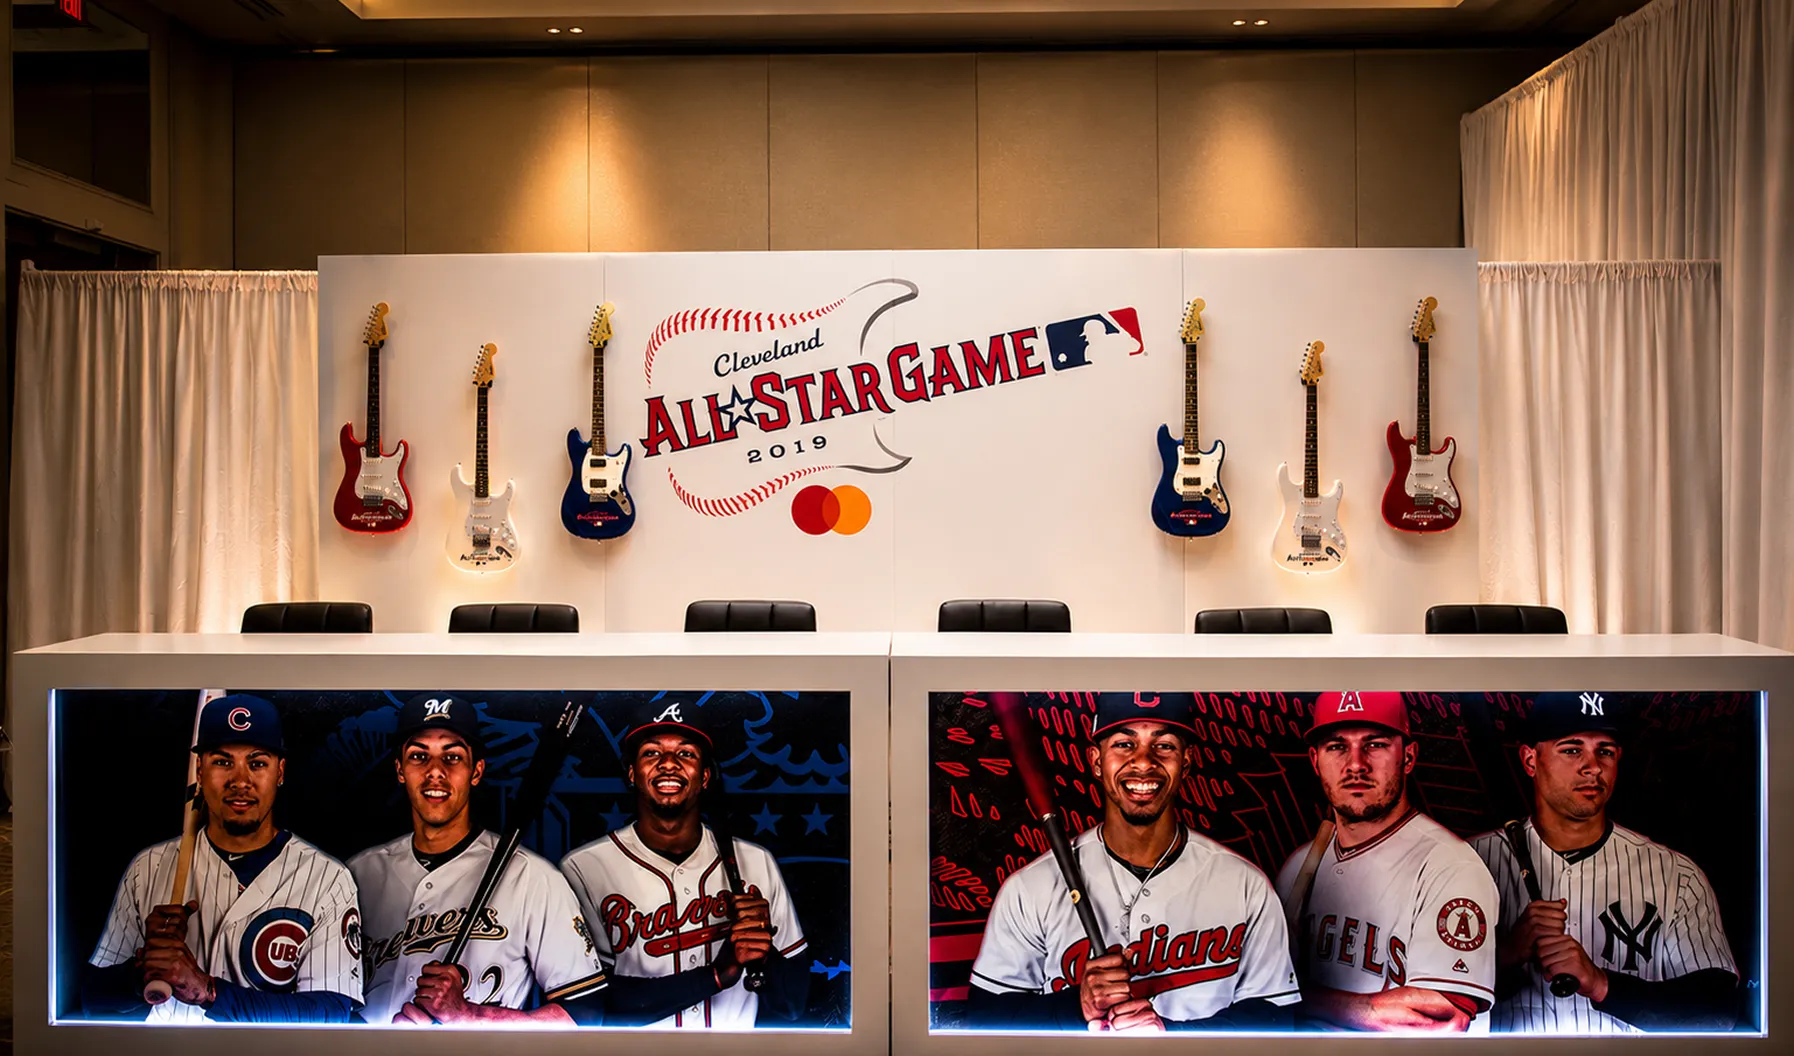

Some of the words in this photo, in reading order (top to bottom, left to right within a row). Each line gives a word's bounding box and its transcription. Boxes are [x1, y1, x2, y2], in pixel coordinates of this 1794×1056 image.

[714, 328, 824, 377] Cleveland
[887, 326, 1046, 403] GAME
[747, 435, 827, 463] 2019
[228, 707, 251, 731] C
[424, 699, 453, 719] M
[653, 702, 683, 722] A
[1598, 900, 1663, 971] NY
[1051, 924, 1247, 992] Idians
